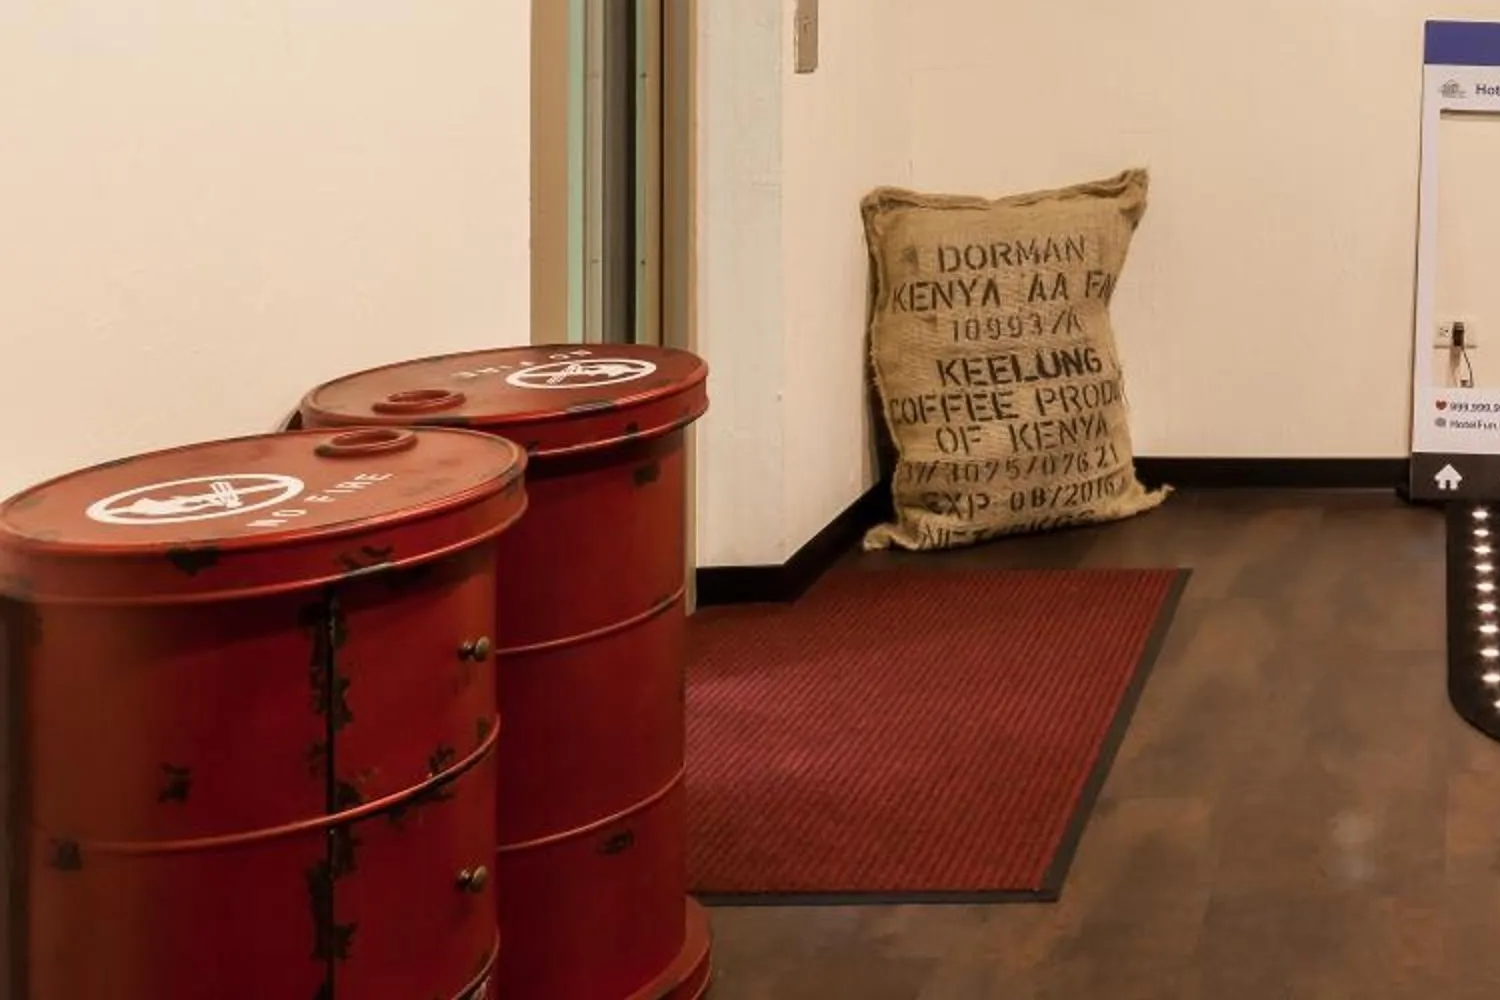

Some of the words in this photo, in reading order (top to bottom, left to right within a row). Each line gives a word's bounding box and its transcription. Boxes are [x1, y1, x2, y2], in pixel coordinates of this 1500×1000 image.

[937, 234, 1086, 273] DORMAN
[892, 277, 1000, 313] KENYA
[1027, 271, 1069, 302] AA
[936, 347, 1102, 387] KEELUNG
[889, 389, 1019, 425] COFFEE
[1035, 380, 1118, 417] PROD
[935, 425, 982, 454] OF
[1008, 412, 1108, 453] KENYA
[922, 491, 990, 519] EXP
